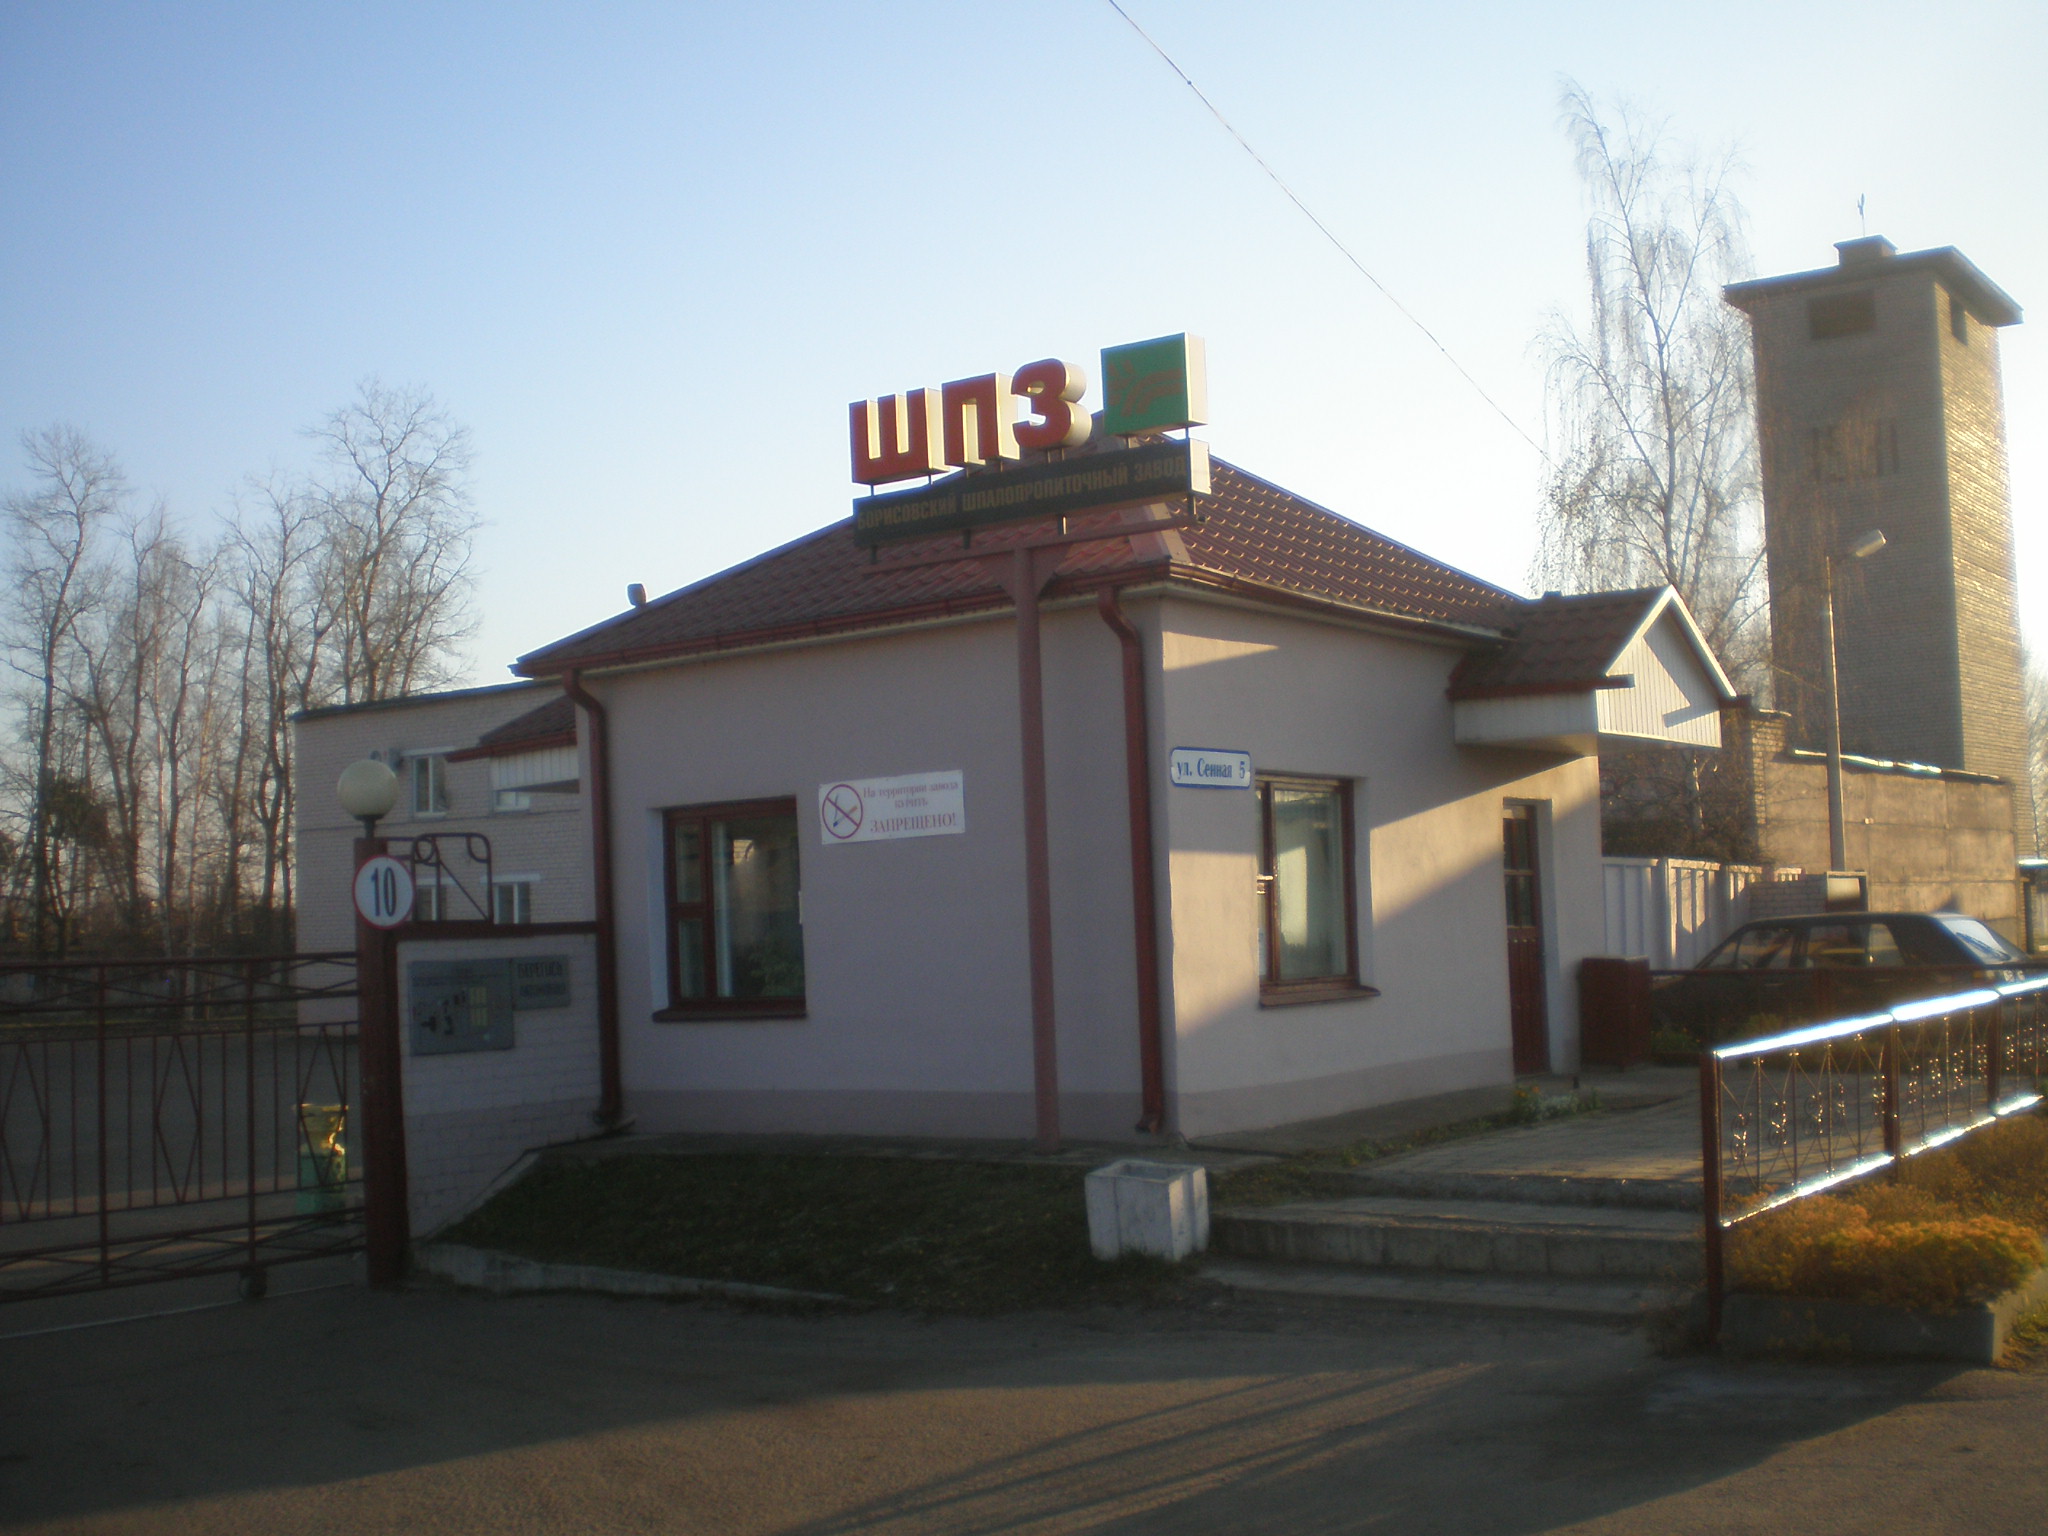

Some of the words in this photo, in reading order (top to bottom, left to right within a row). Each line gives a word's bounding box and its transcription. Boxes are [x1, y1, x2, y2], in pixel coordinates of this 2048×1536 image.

[849, 357, 1085, 484] ШПЗ
[857, 492, 957, 530] БОРИСОВСКИЙ
[962, 463, 1128, 511] ШПАЛОПРОПИТОЧНЫЙ
[1134, 456, 1187, 482] ЗАВОД
[1176, 761, 1192, 779] ул.
[1197, 757, 1233, 778] Сенная
[1239, 761, 1246, 779] 5
[863, 787, 876, 798] На
[879, 784, 927, 798] территории
[929, 781, 959, 792] завода
[870, 812, 957, 833] ЗАПРЕЩЕНО!
[371, 867, 396, 917] 10
